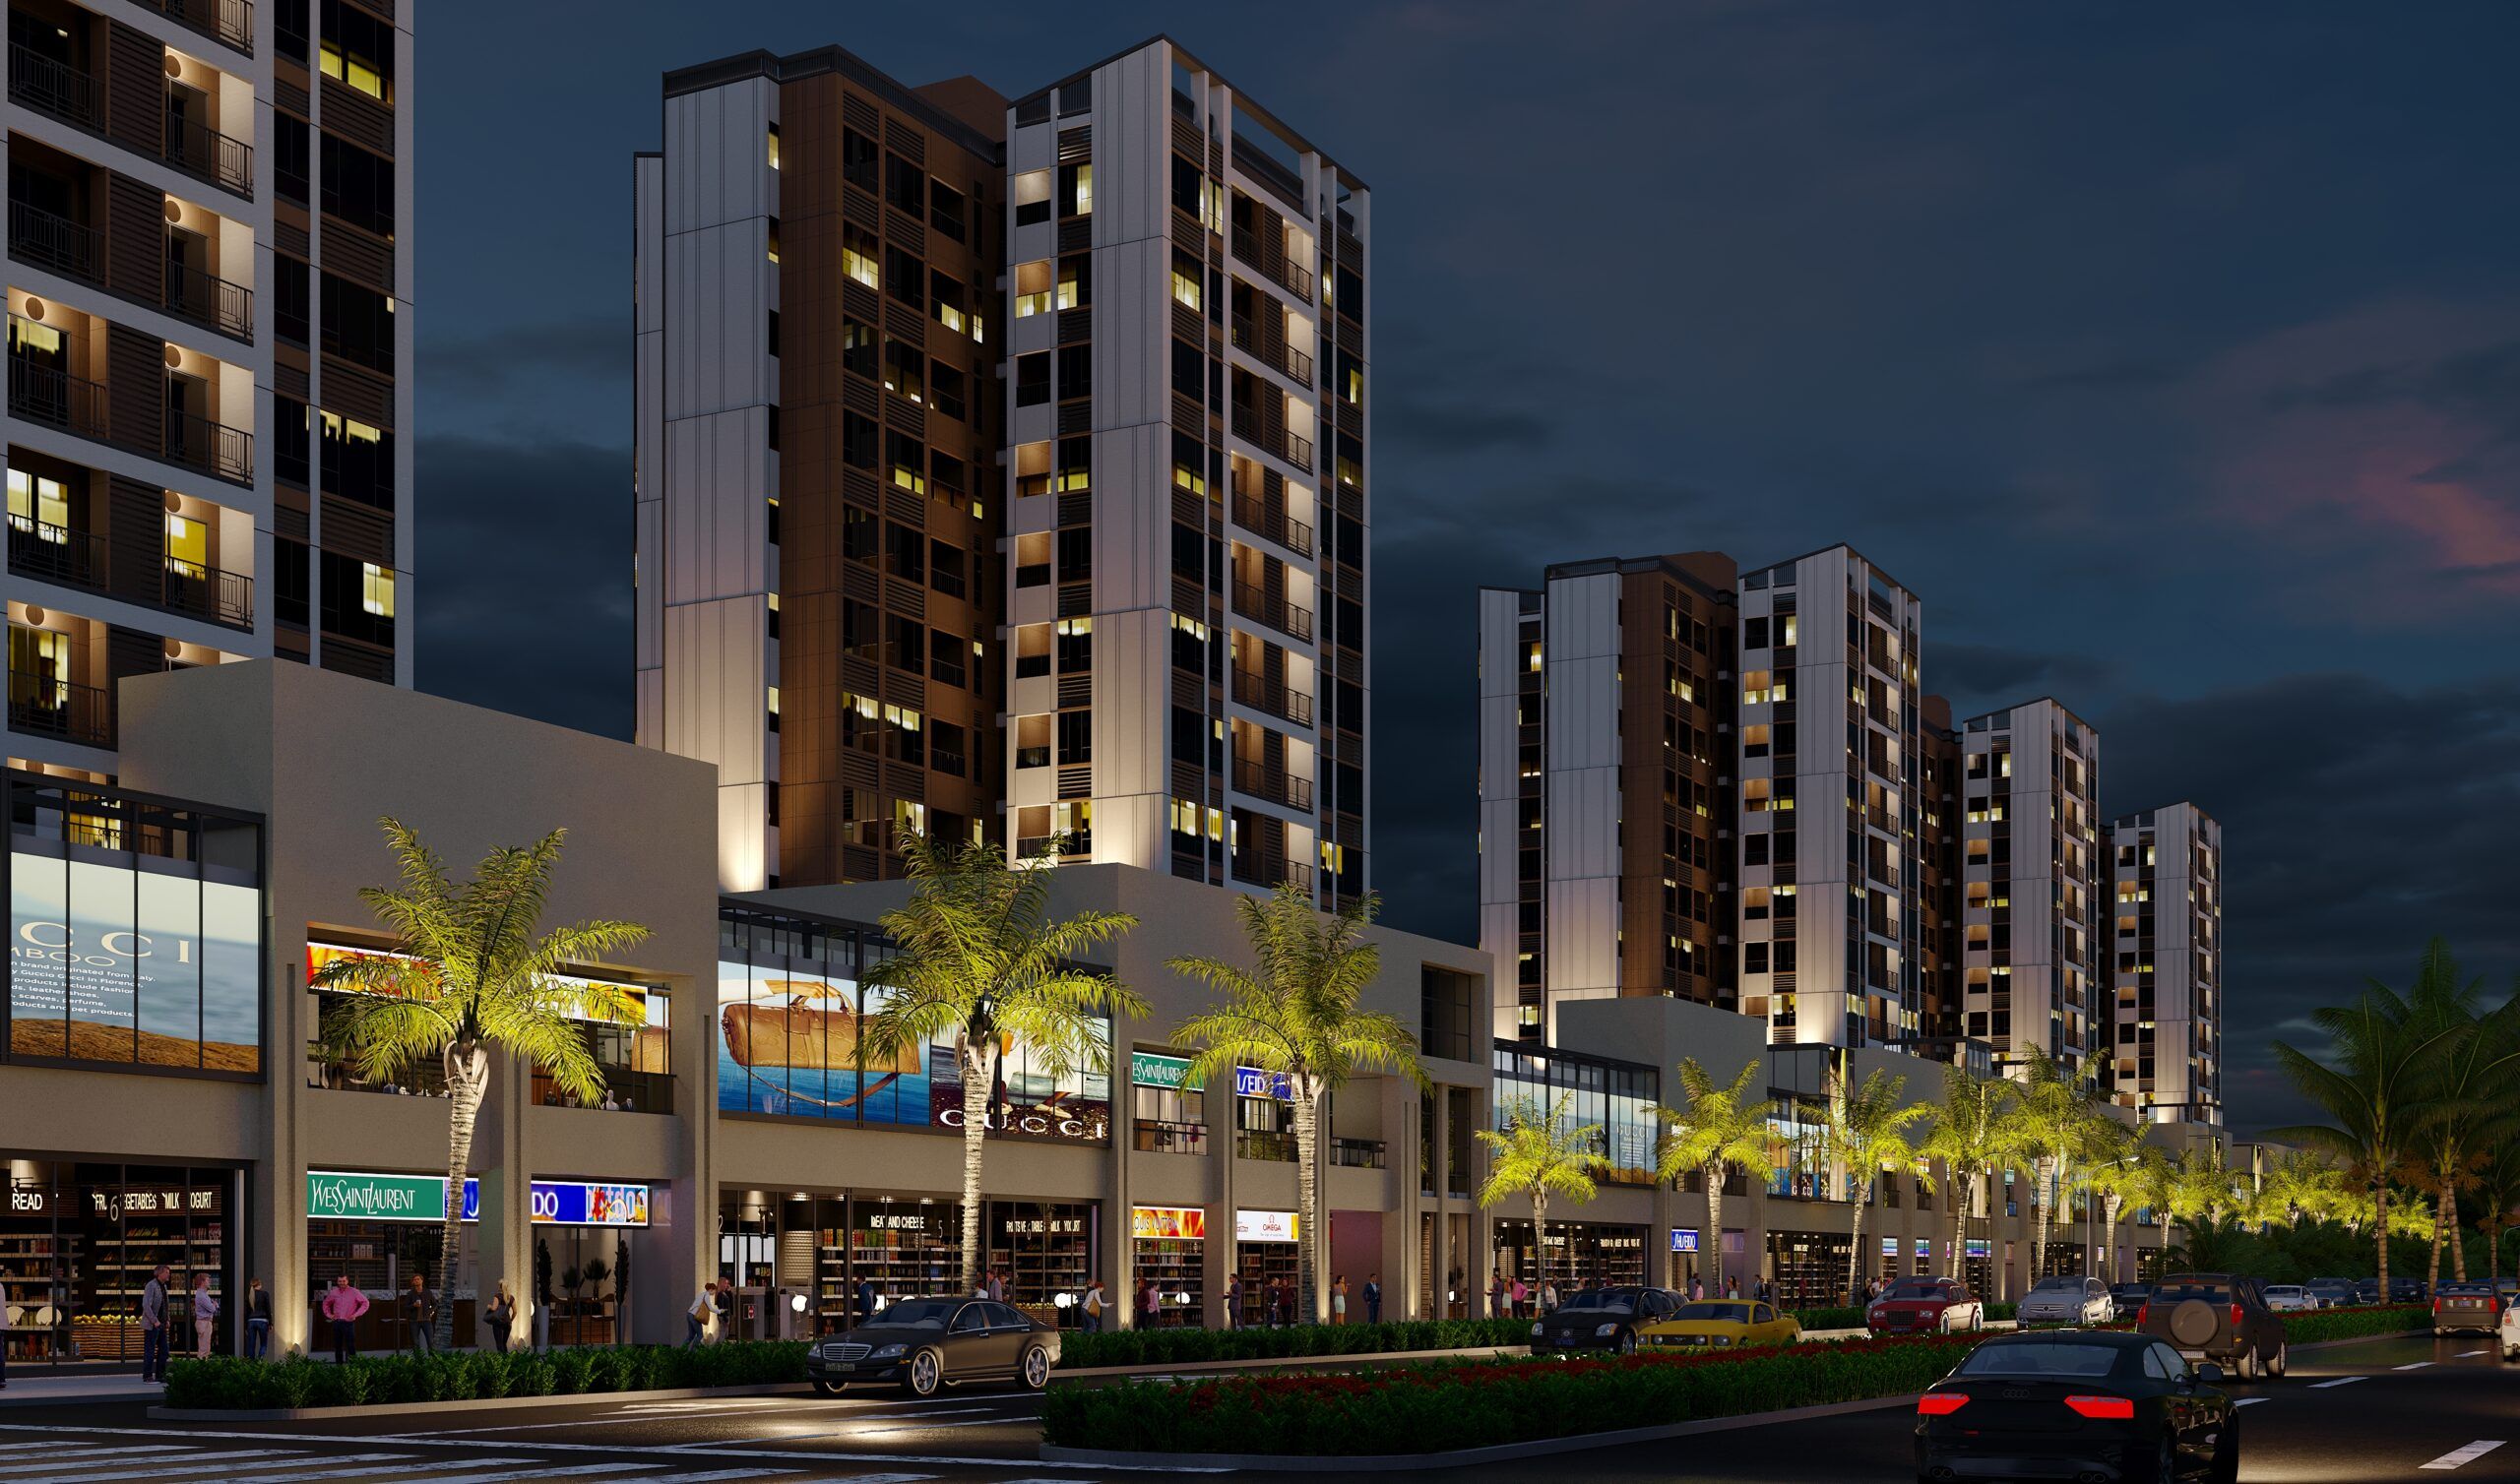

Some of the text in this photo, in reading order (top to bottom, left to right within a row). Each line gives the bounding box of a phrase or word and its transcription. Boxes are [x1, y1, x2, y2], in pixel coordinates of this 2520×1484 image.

[21, 960, 49, 969] brand
[107, 970, 130, 979] from
[21, 969, 54, 978] Guccio
[14, 977, 58, 987] products
[30, 986, 66, 995] leather
[110, 1195, 119, 1221] 6
[887, 1215, 901, 1228] AND
[938, 1219, 943, 1239] 5
